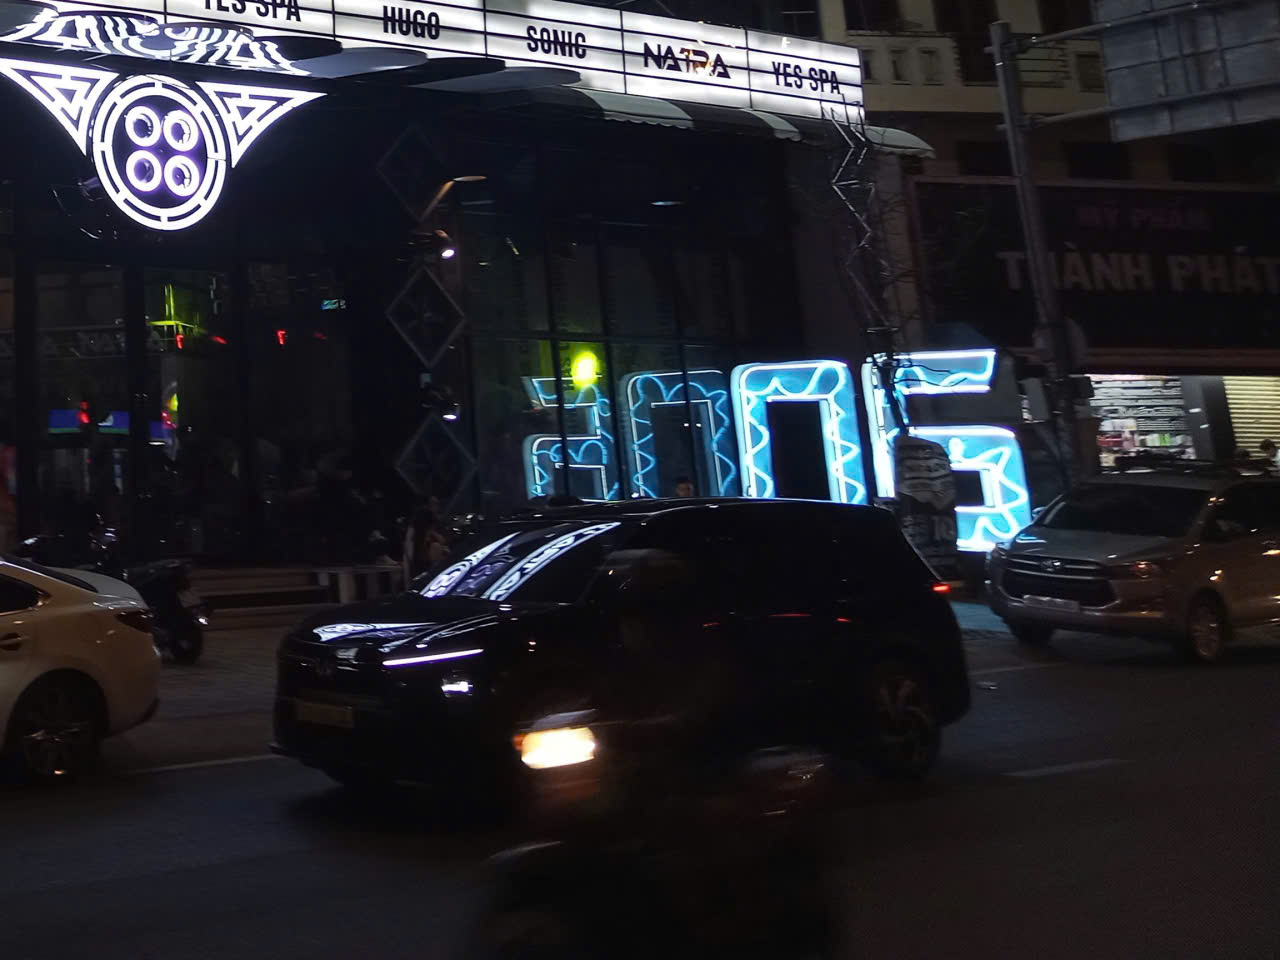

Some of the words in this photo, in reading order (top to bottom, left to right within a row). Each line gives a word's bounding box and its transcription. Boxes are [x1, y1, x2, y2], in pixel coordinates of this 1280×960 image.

[382, 5, 441, 41] HUGO
[526, 25, 587, 59] SONIC
[643, 42, 731, 79] NATRA
[772, 61, 803, 90] YES
[809, 66, 841, 95] SPA
